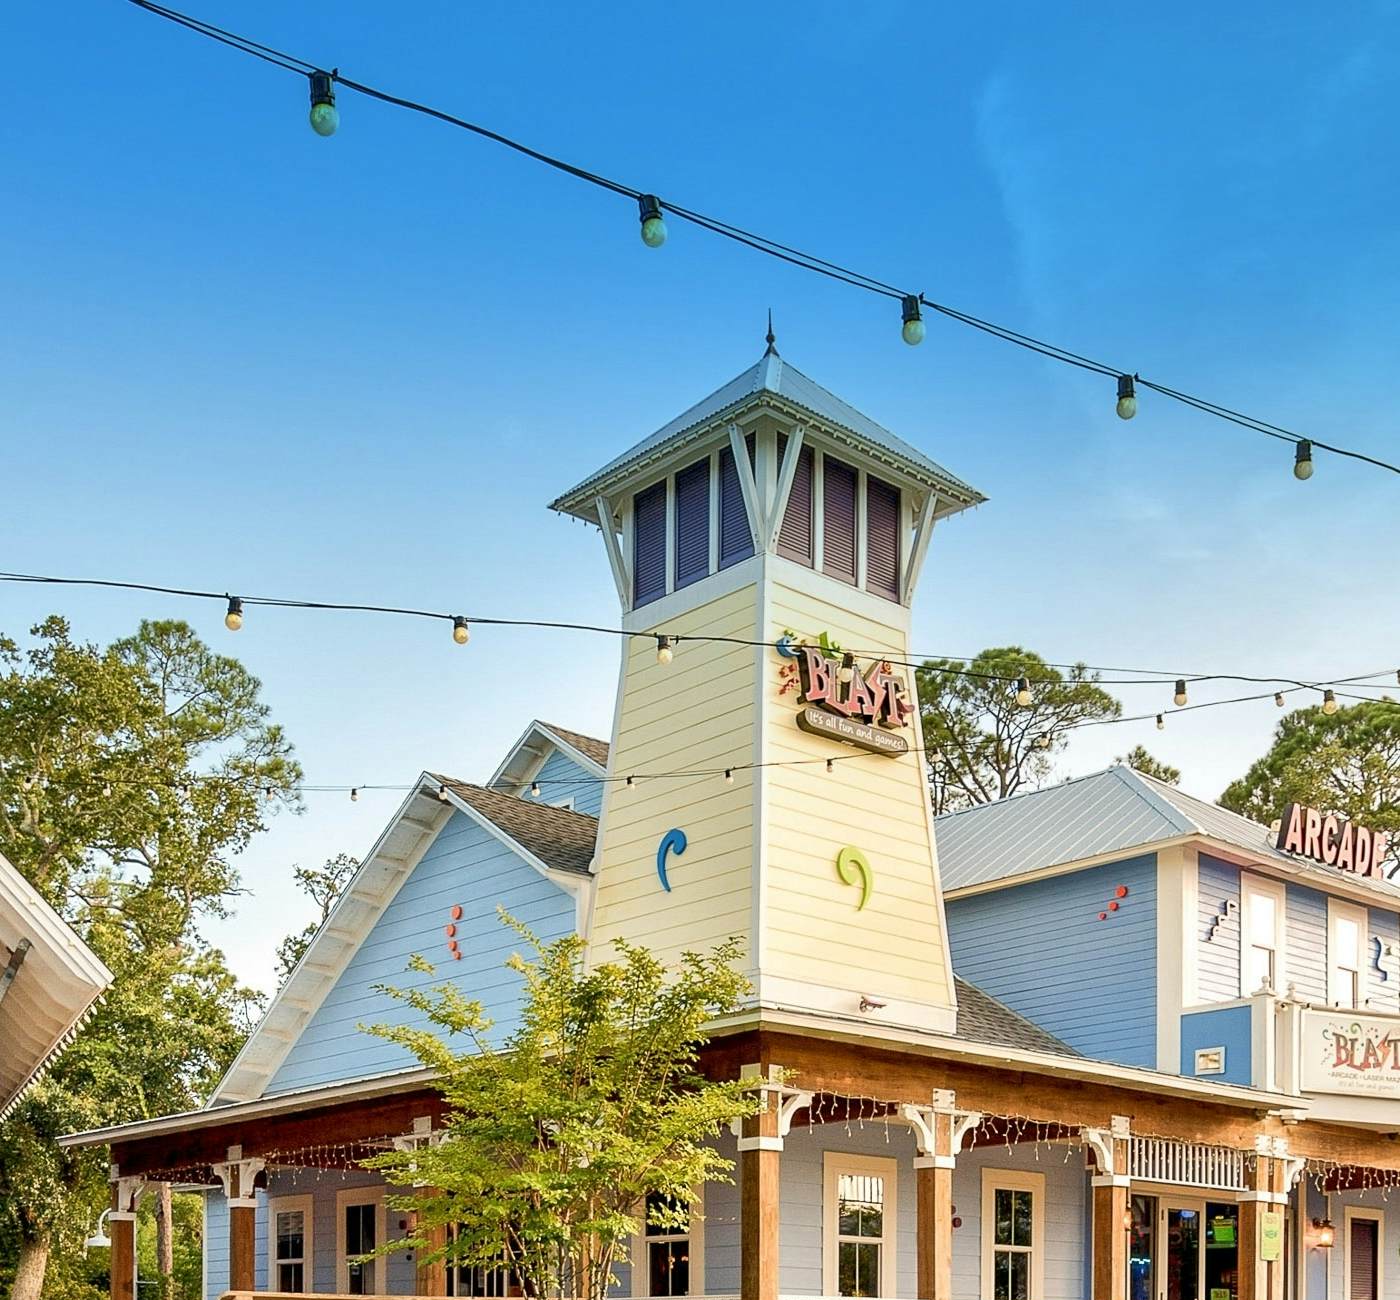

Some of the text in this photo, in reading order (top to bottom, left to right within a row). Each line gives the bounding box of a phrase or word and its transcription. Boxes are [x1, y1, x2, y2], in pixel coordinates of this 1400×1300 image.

[802, 647, 905, 725] BLAST
[810, 711, 823, 725] It's
[825, 716, 836, 729] all
[839, 721, 854, 734] fun
[856, 729, 873, 740] and
[1285, 802, 1387, 880] ARCADE
[1332, 1031, 1400, 1072] BLAST
